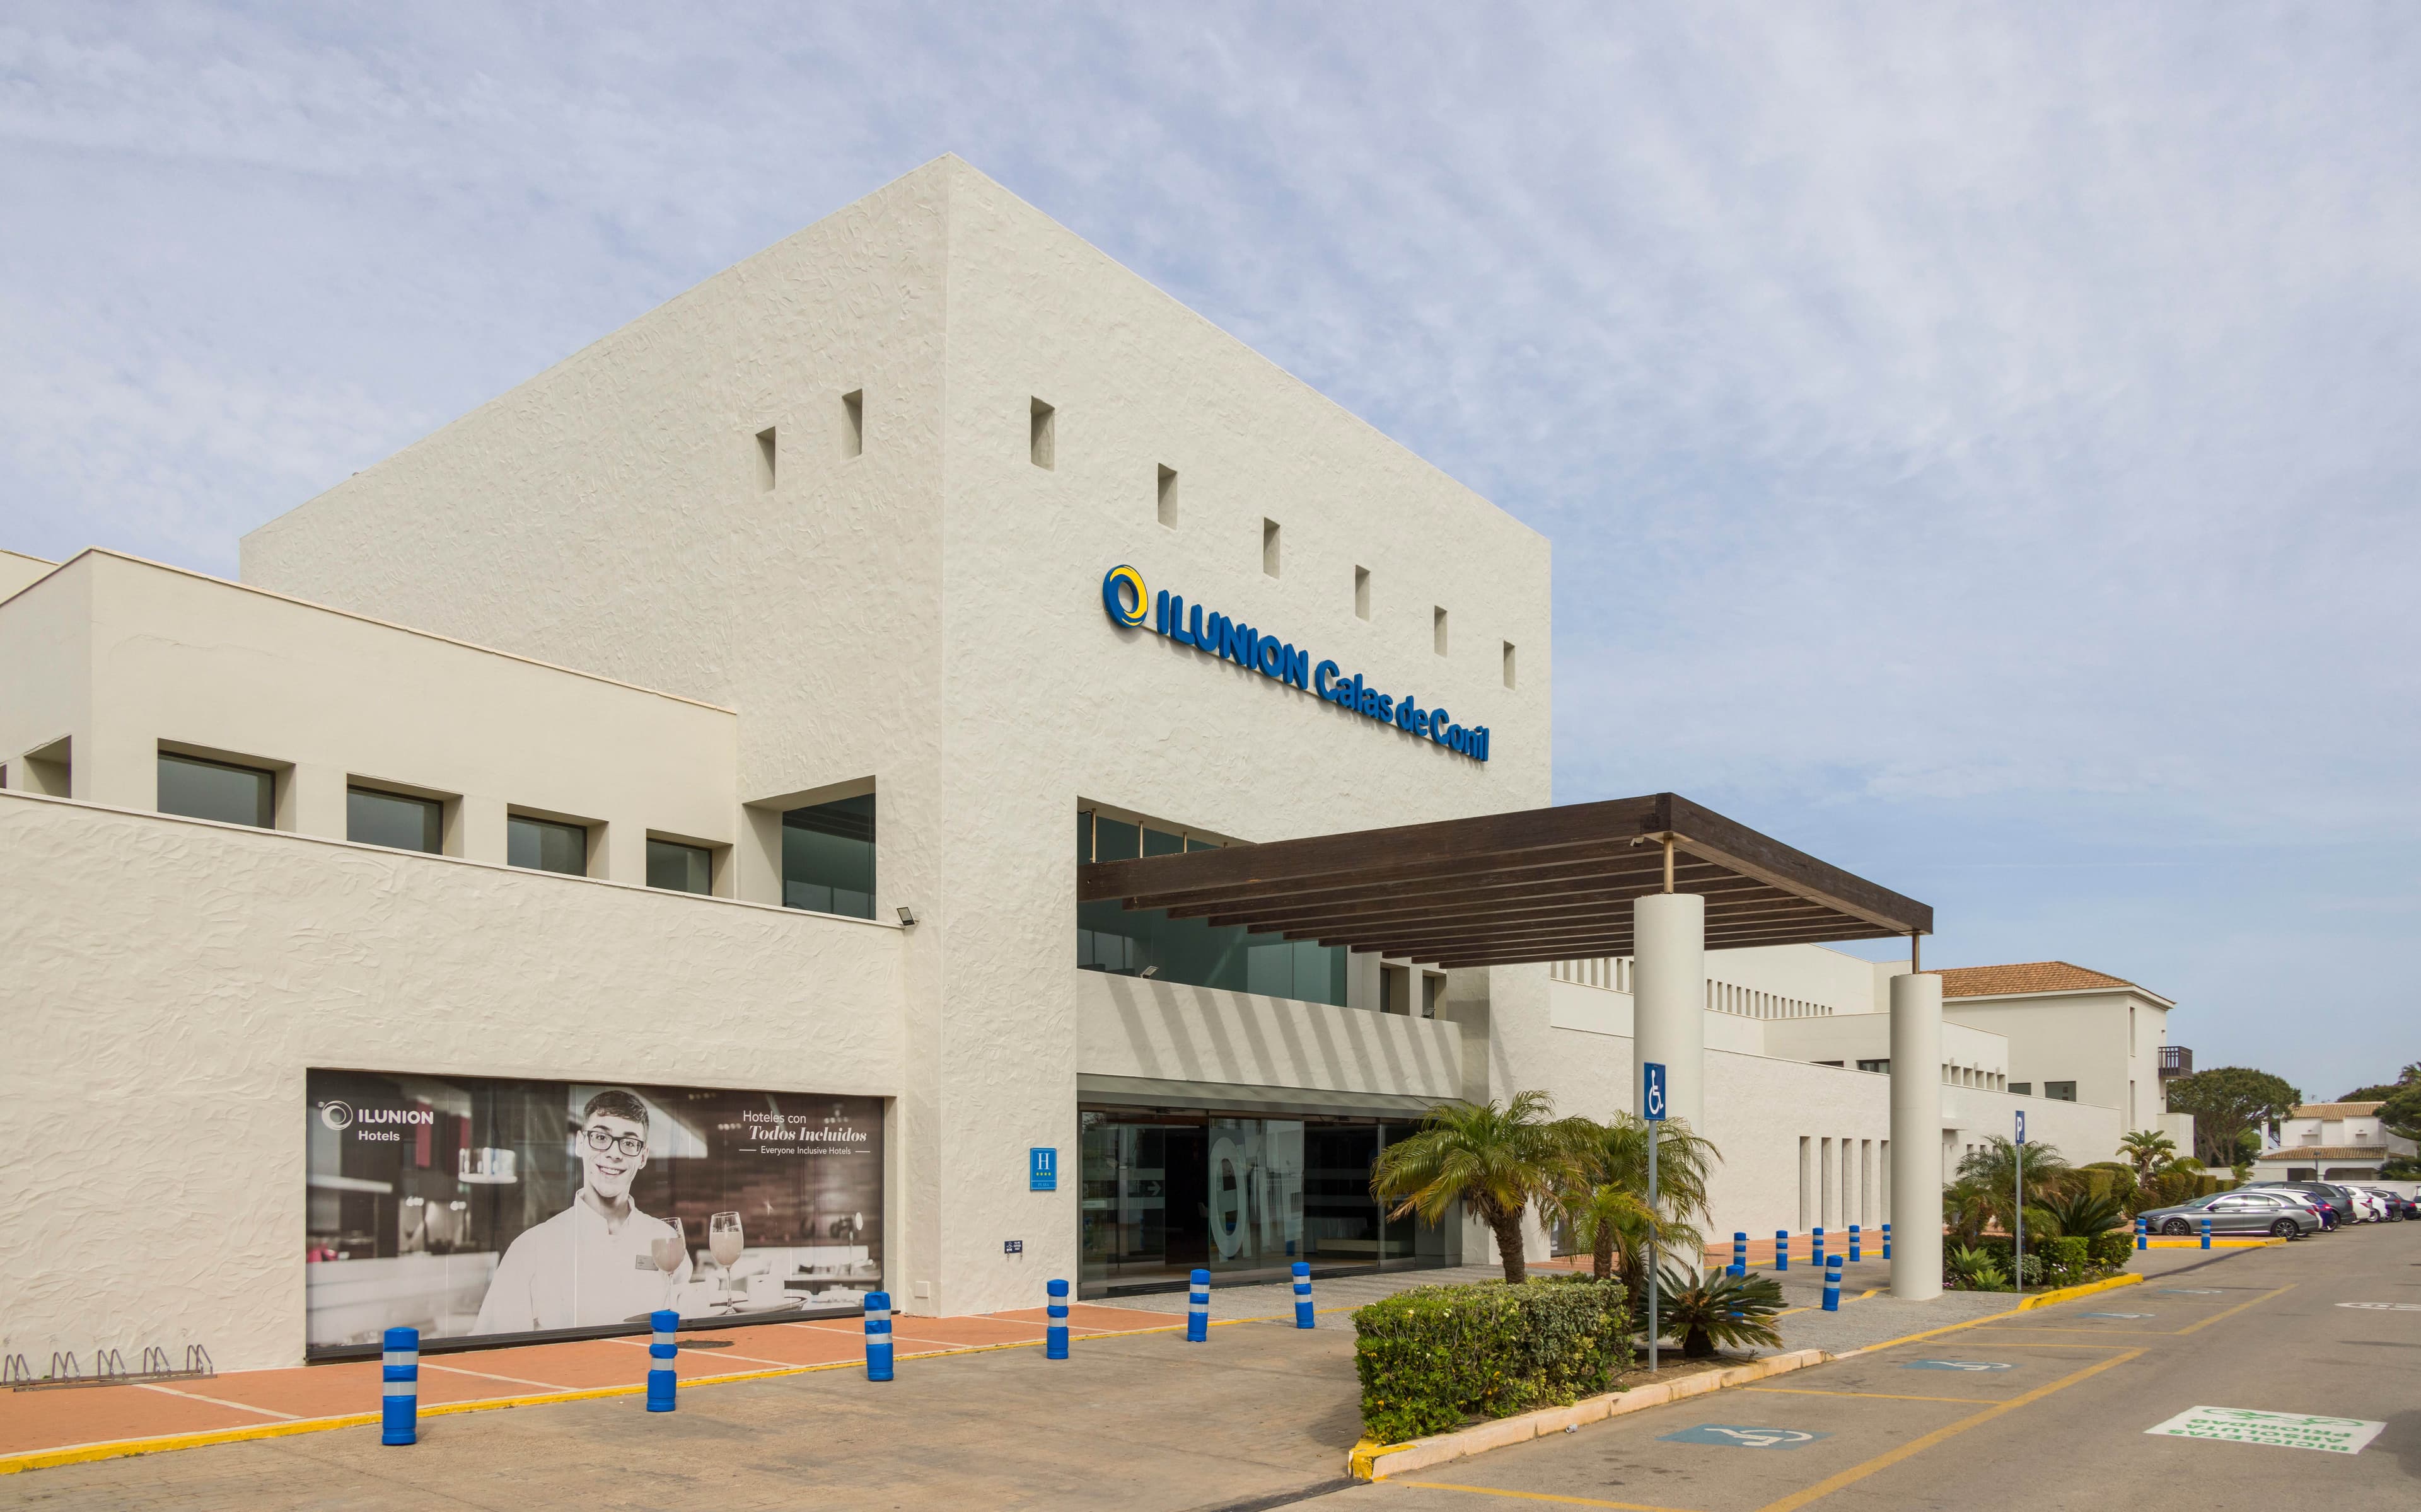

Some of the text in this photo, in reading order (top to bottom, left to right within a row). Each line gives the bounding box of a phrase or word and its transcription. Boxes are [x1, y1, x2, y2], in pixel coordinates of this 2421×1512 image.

[1157, 589, 1490, 762] ILUNION Calas de Conil
[358, 1109, 434, 1124] ILUNION
[743, 1110, 806, 1123] Hoteles con
[358, 1130, 400, 1141] Hotels
[749, 1125, 867, 1141] Todos Incluidos
[2017, 1116, 2023, 1141] P
[760, 1145, 795, 1156] Everyone
[797, 1146, 827, 1155] Inclusive
[1036, 1153, 1050, 1170] H
[2185, 1424, 2345, 1443] ABSOLUTA
[2190, 1419, 2352, 1438] PRIORIDAD
[2168, 1429, 2350, 1451] BICICLETAS
